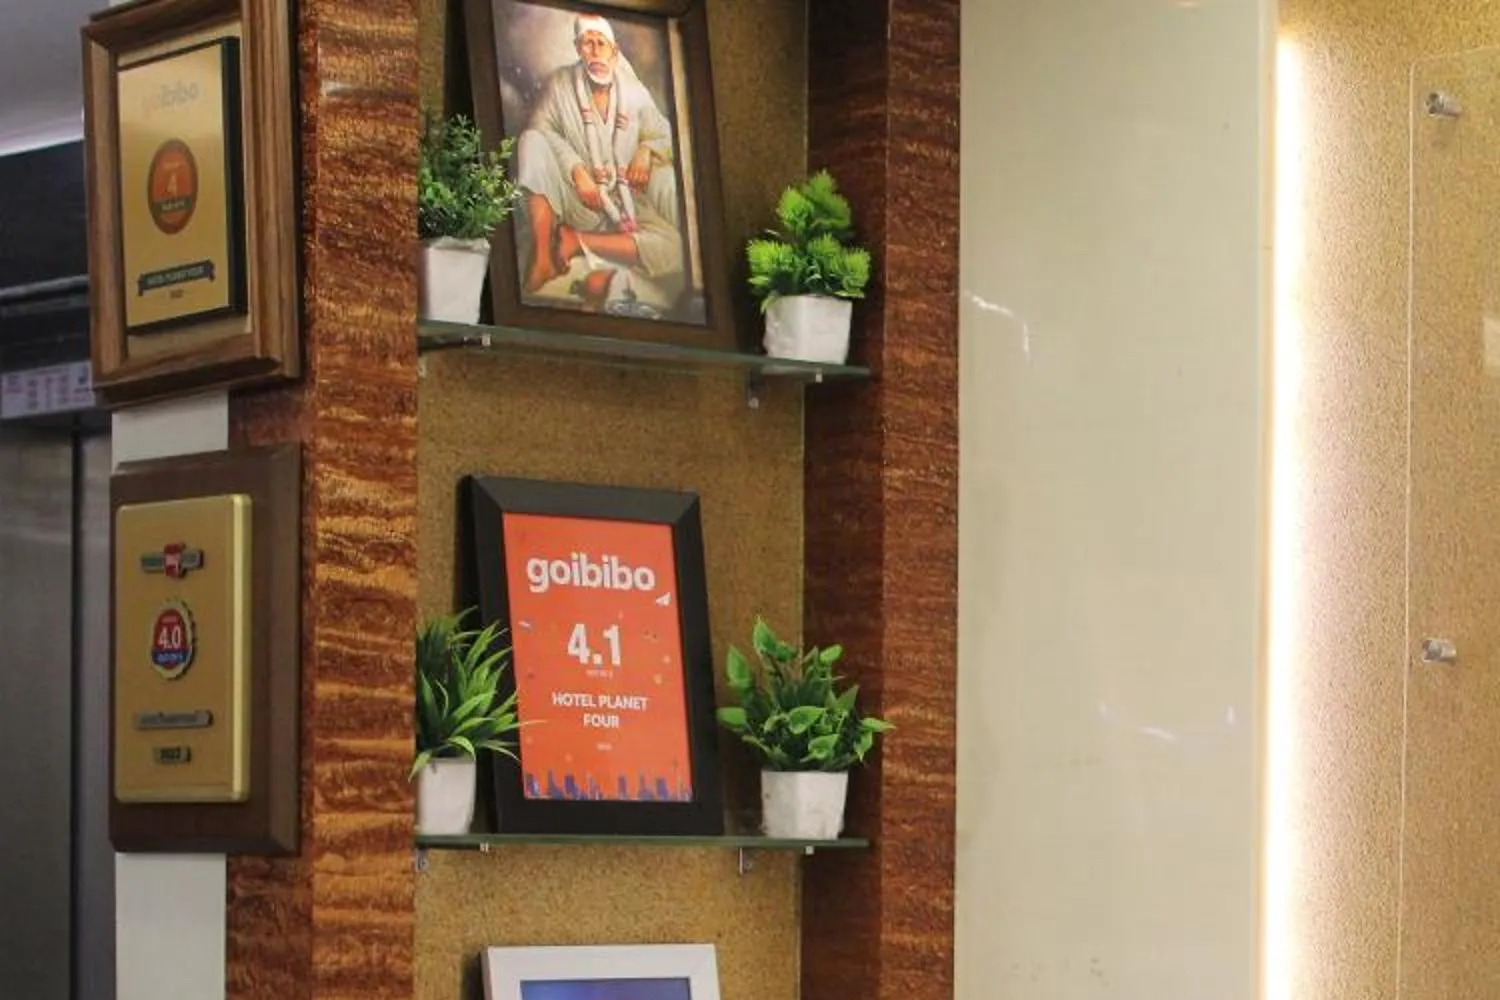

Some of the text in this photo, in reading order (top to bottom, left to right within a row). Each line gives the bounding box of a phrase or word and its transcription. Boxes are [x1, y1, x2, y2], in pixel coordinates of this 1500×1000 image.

[527, 552, 655, 592] goibibo
[158, 625, 181, 650] 4.0
[567, 623, 621, 666] 4.1
[552, 691, 648, 711] HOTEL PLANET
[583, 713, 620, 729] FOUR
